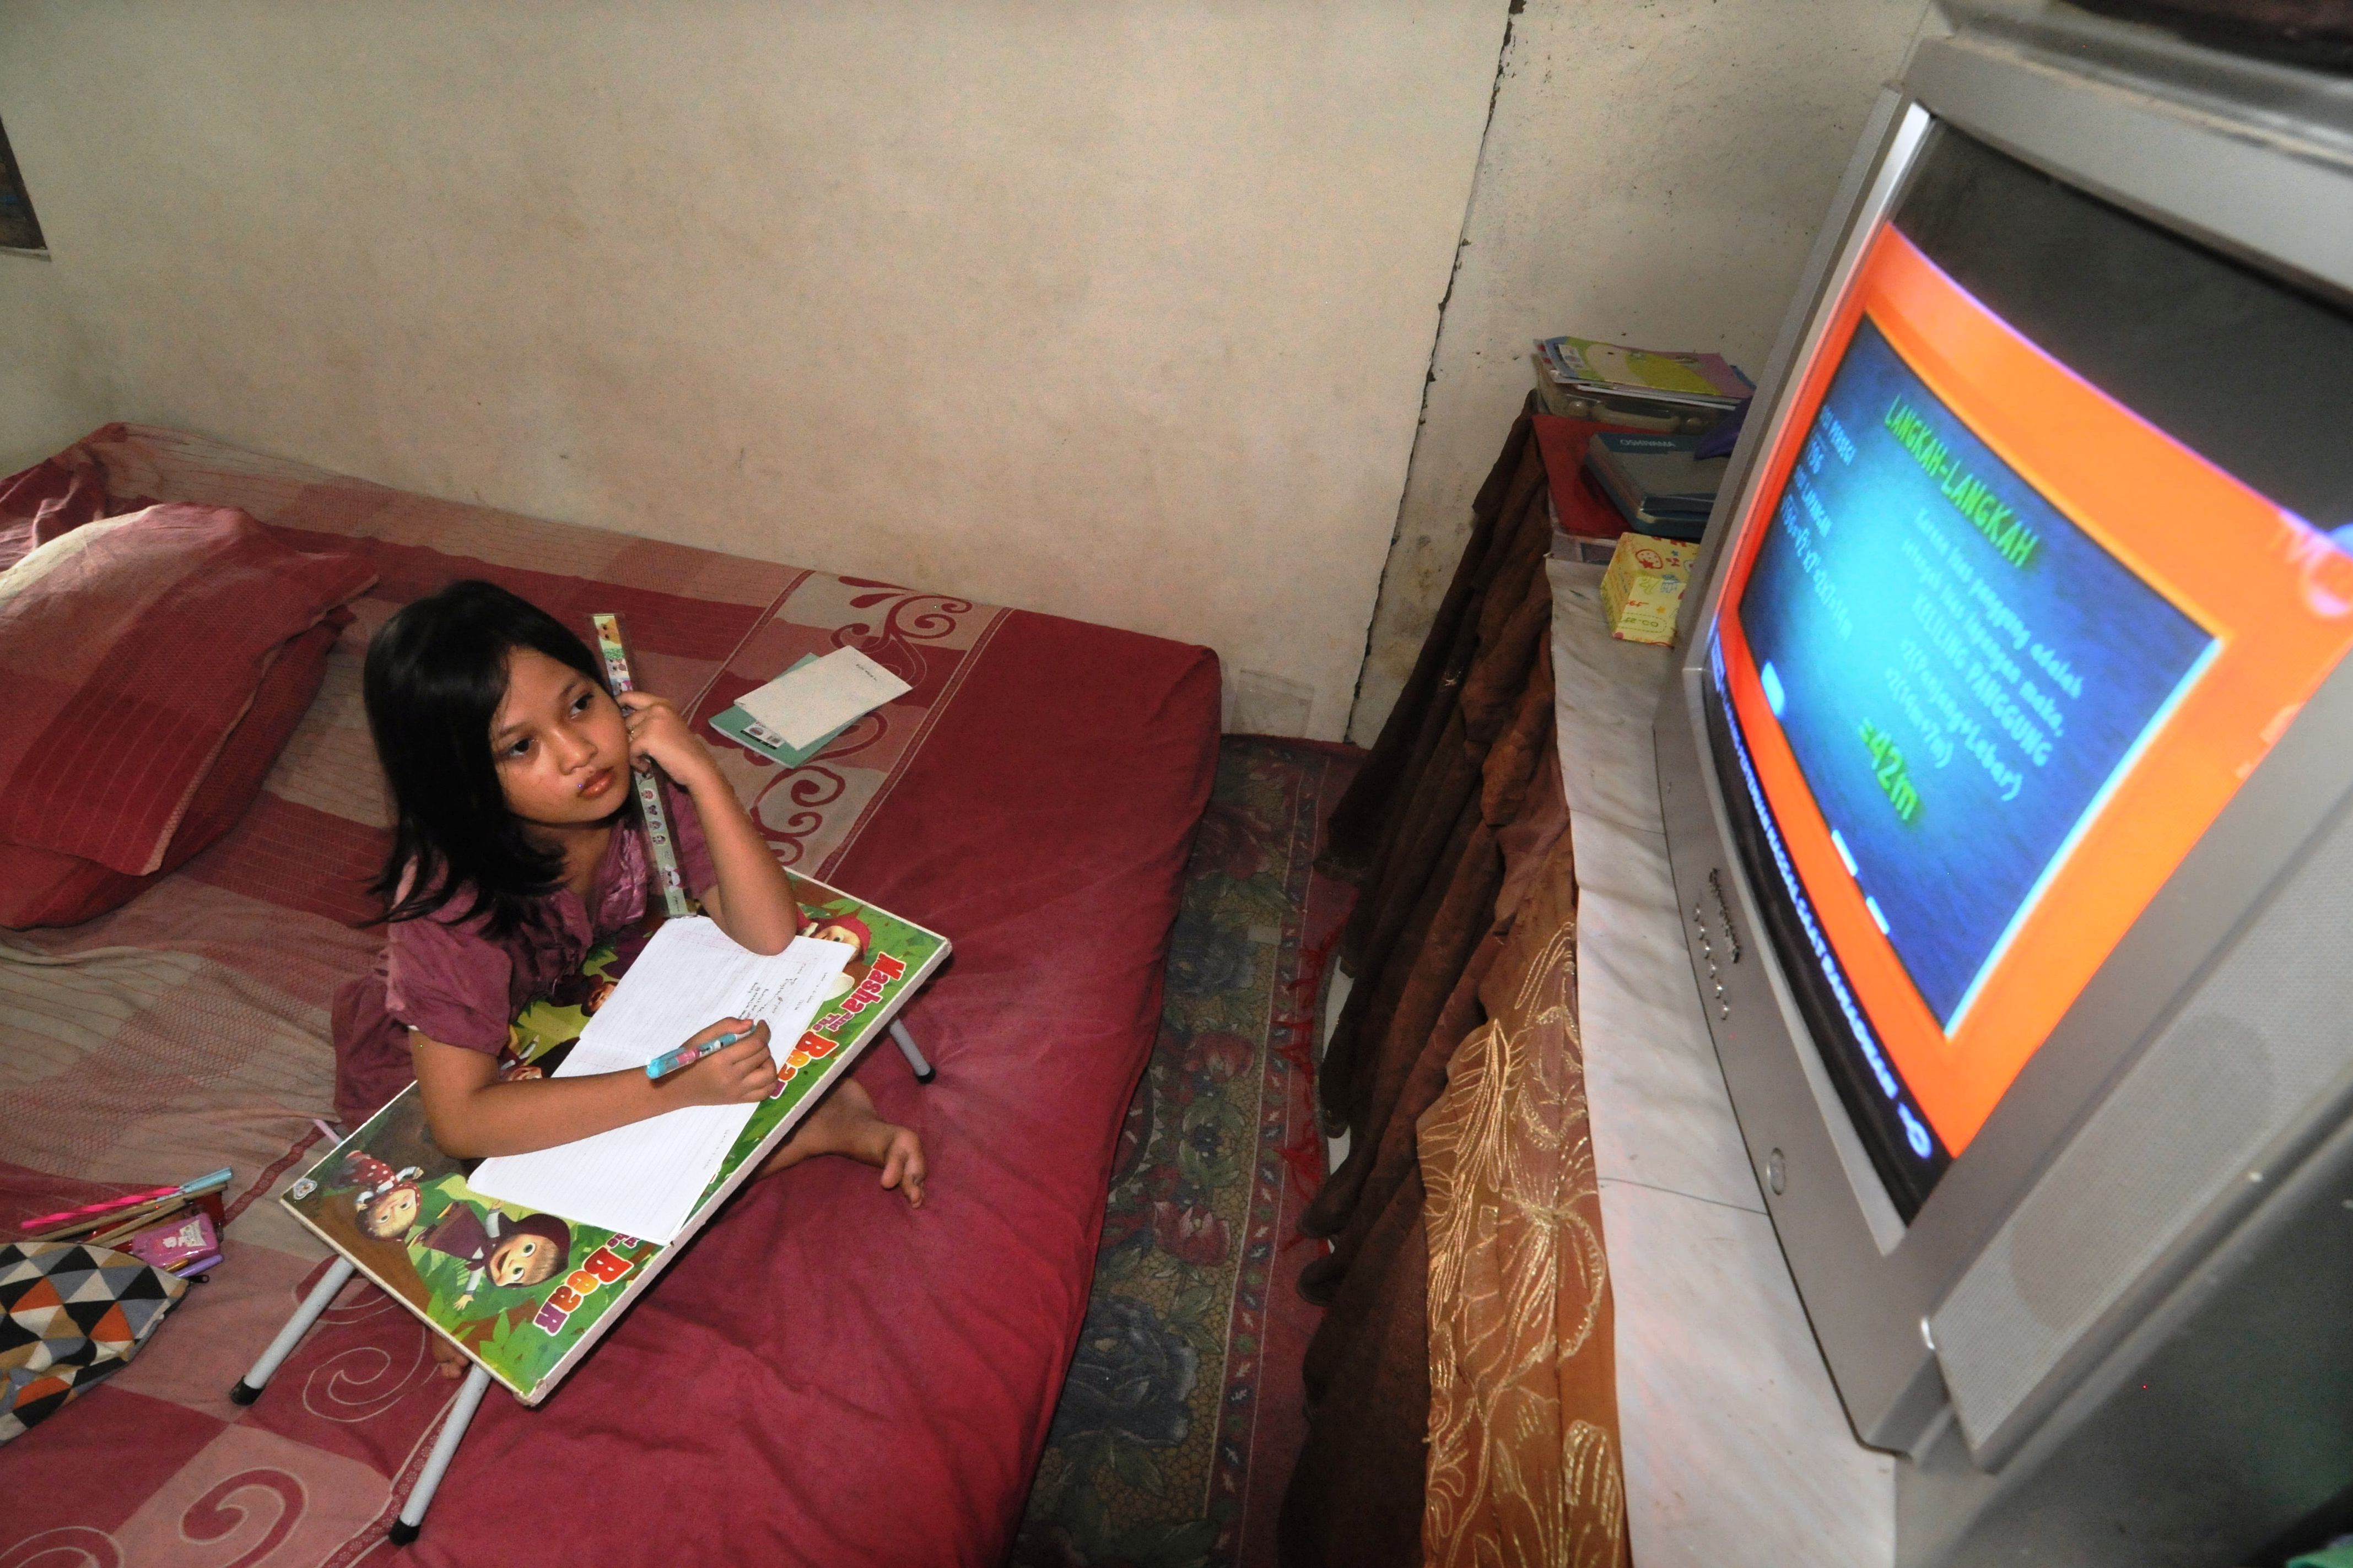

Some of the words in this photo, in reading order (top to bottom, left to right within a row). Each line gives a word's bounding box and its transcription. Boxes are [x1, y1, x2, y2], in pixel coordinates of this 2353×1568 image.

[1885, 393, 2039, 567] LANGKAH-LANGKAH
[1911, 593, 1969, 670] KELILING
[1966, 661, 2053, 766] PANGGUNG
[1967, 578, 2031, 651] panggung
[2030, 643, 2084, 699] adalah
[1858, 716, 1919, 820] =42m
[840, 951, 906, 1013] Masha
